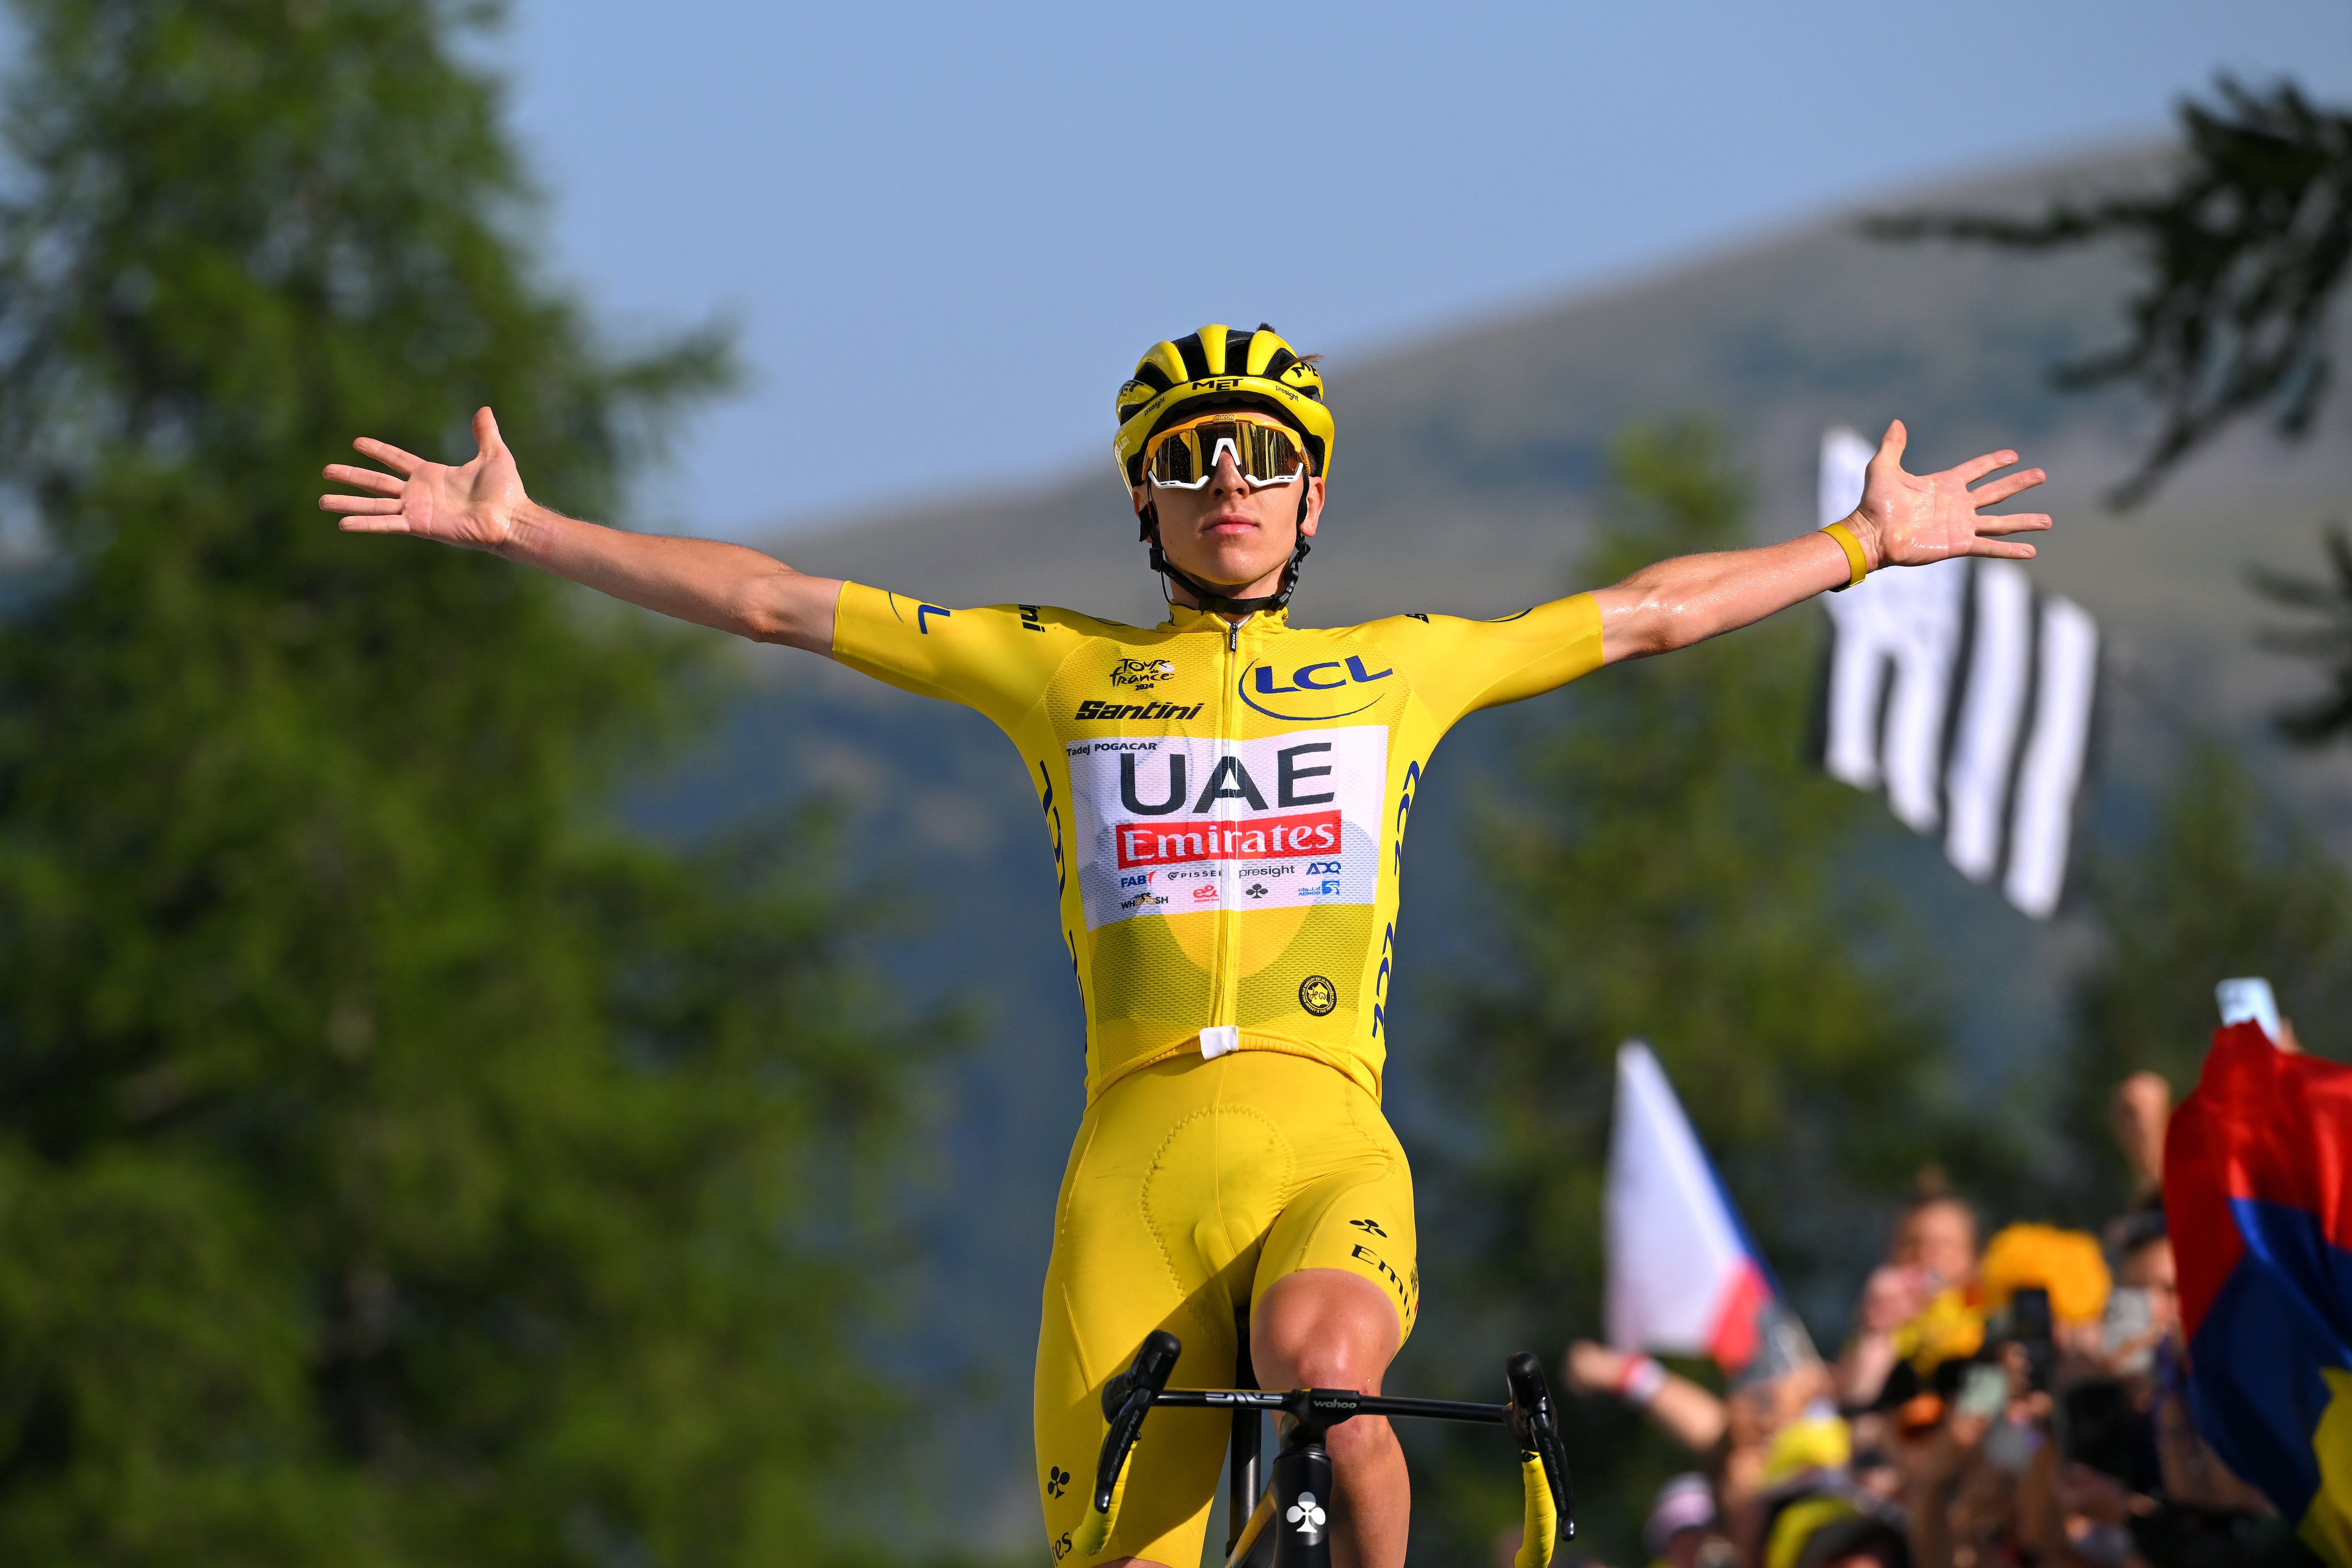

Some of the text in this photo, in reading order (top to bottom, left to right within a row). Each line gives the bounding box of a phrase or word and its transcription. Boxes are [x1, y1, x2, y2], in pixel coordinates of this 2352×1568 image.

[1192, 379, 1243, 390] MET
[1276, 386, 1298, 401] presight
[1144, 396, 1165, 416] presight
[1255, 655, 1393, 694] LCL
[1075, 700, 1205, 720] Santini
[1066, 743, 1157, 757] Tadej POGACAR
[1120, 742, 1335, 816] UAE
[1122, 823, 1335, 861] Emirates
[1239, 865, 1295, 879] presight
[1306, 862, 1341, 875] ADQ
[1121, 875, 1146, 888] FAB
[1304, 978, 1315, 988] MAILLOT
[1314, 1399, 1357, 1409] wahoo
